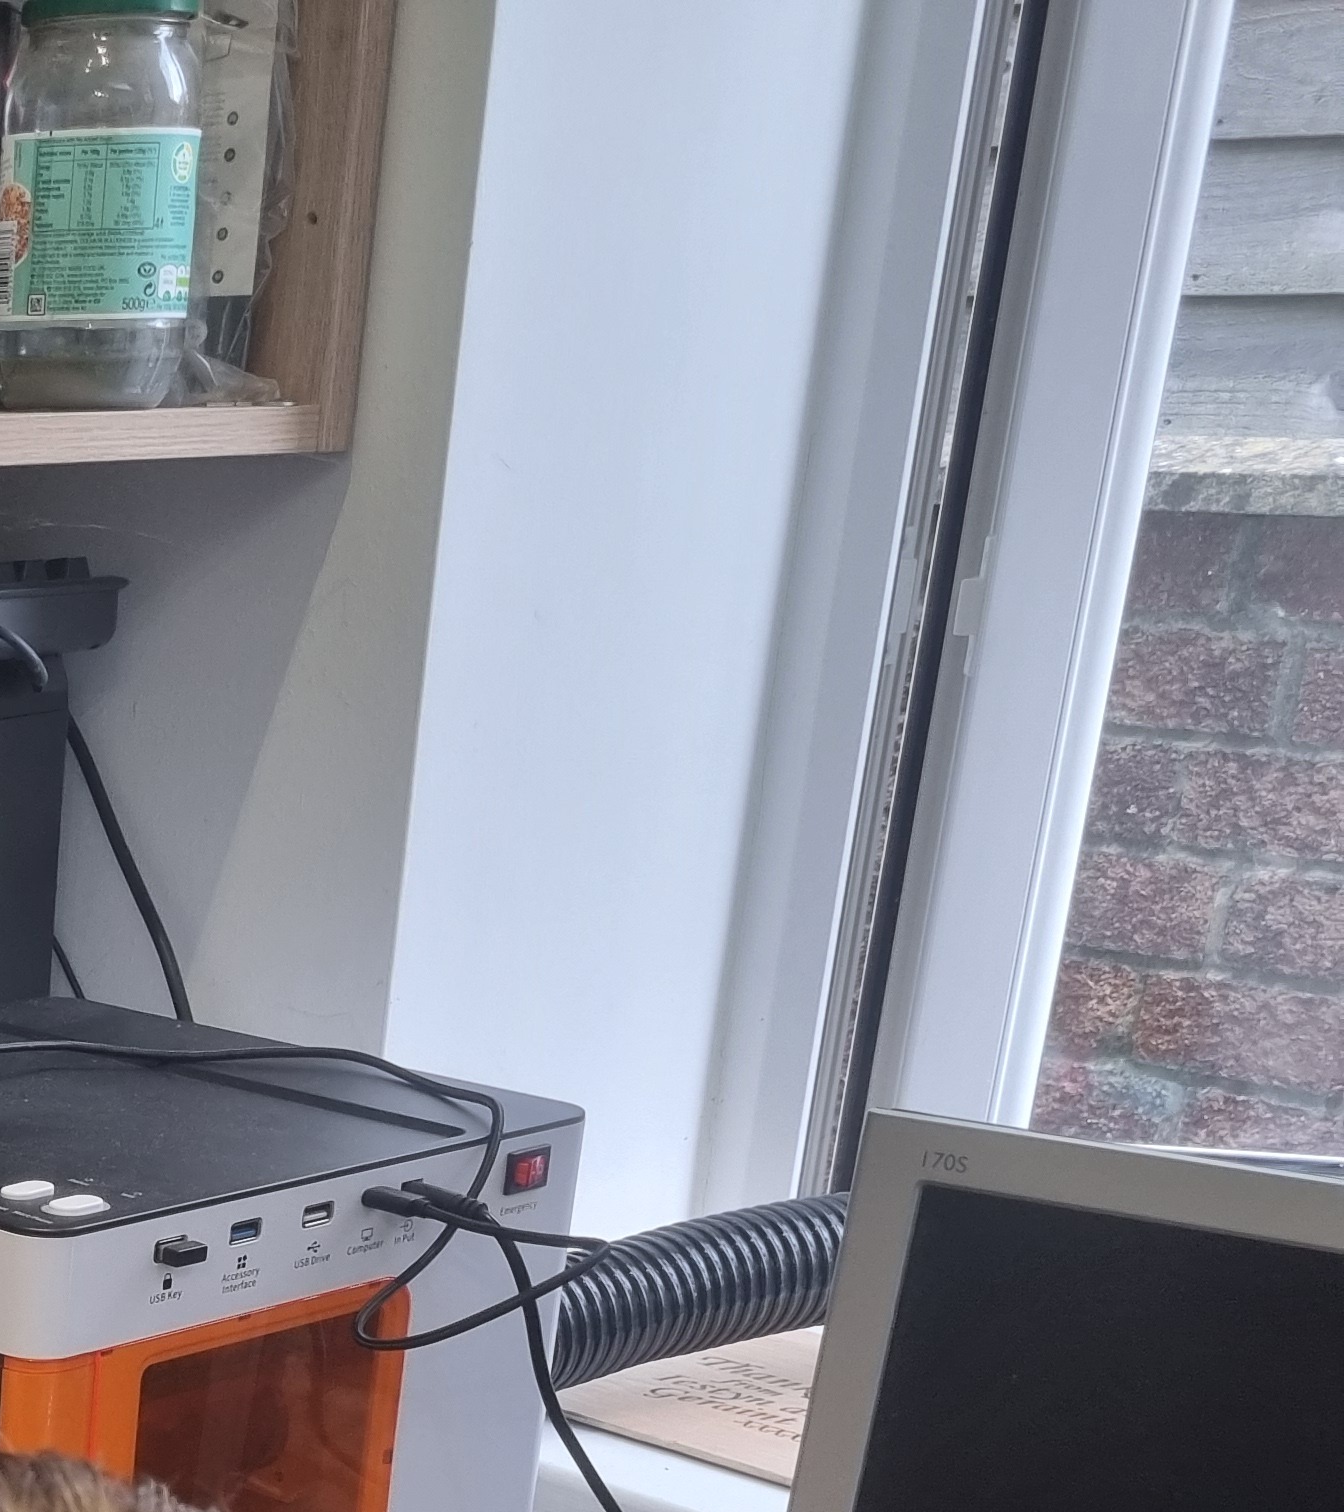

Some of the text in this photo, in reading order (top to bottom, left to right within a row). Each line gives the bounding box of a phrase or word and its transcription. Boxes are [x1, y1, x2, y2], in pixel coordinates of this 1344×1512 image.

[121, 297, 146, 311] 500g
[499, 1200, 539, 1217] Emergency
[346, 1238, 385, 1256] Computer
[293, 1253, 331, 1269] USB Drive
[221, 1266, 261, 1283] Accessory
[222, 1279, 257, 1294] Interface
[149, 1290, 183, 1305] USB Key
